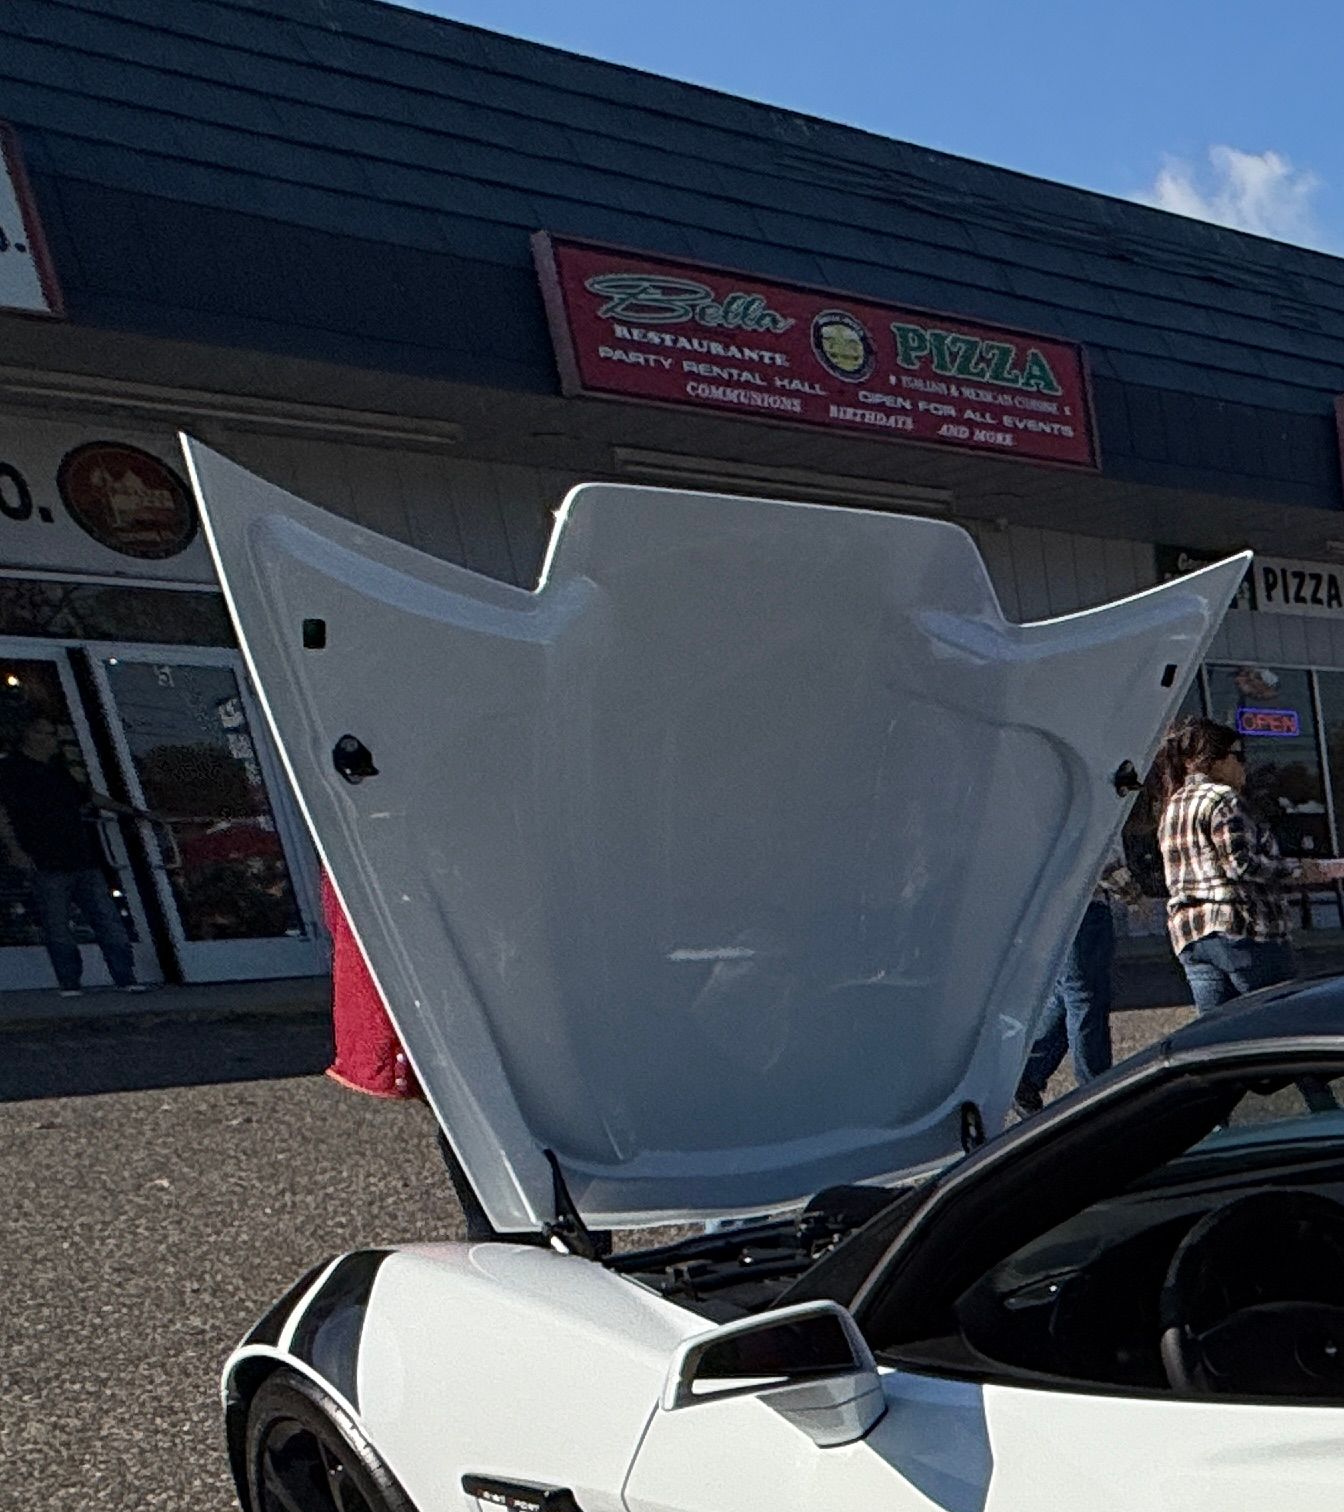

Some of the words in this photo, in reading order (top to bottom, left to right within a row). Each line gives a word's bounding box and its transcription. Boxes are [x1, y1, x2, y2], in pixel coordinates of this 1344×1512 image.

[584, 272, 795, 333] Bella
[614, 324, 790, 367] RESTAURANTE
[891, 322, 1062, 396] PIZZA
[598, 346, 673, 370] PARTY
[683, 360, 767, 387] RENTAL
[774, 376, 827, 396] HALL
[686, 381, 802, 413] COMMUNIONS
[858, 391, 913, 410] OPEN
[918, 400, 957, 418] FOR
[963, 409, 997, 424] ALL
[1003, 415, 1074, 437] EVENTS
[1263, 566, 1342, 609] PIZZA
[1241, 713, 1297, 733] OPEN
